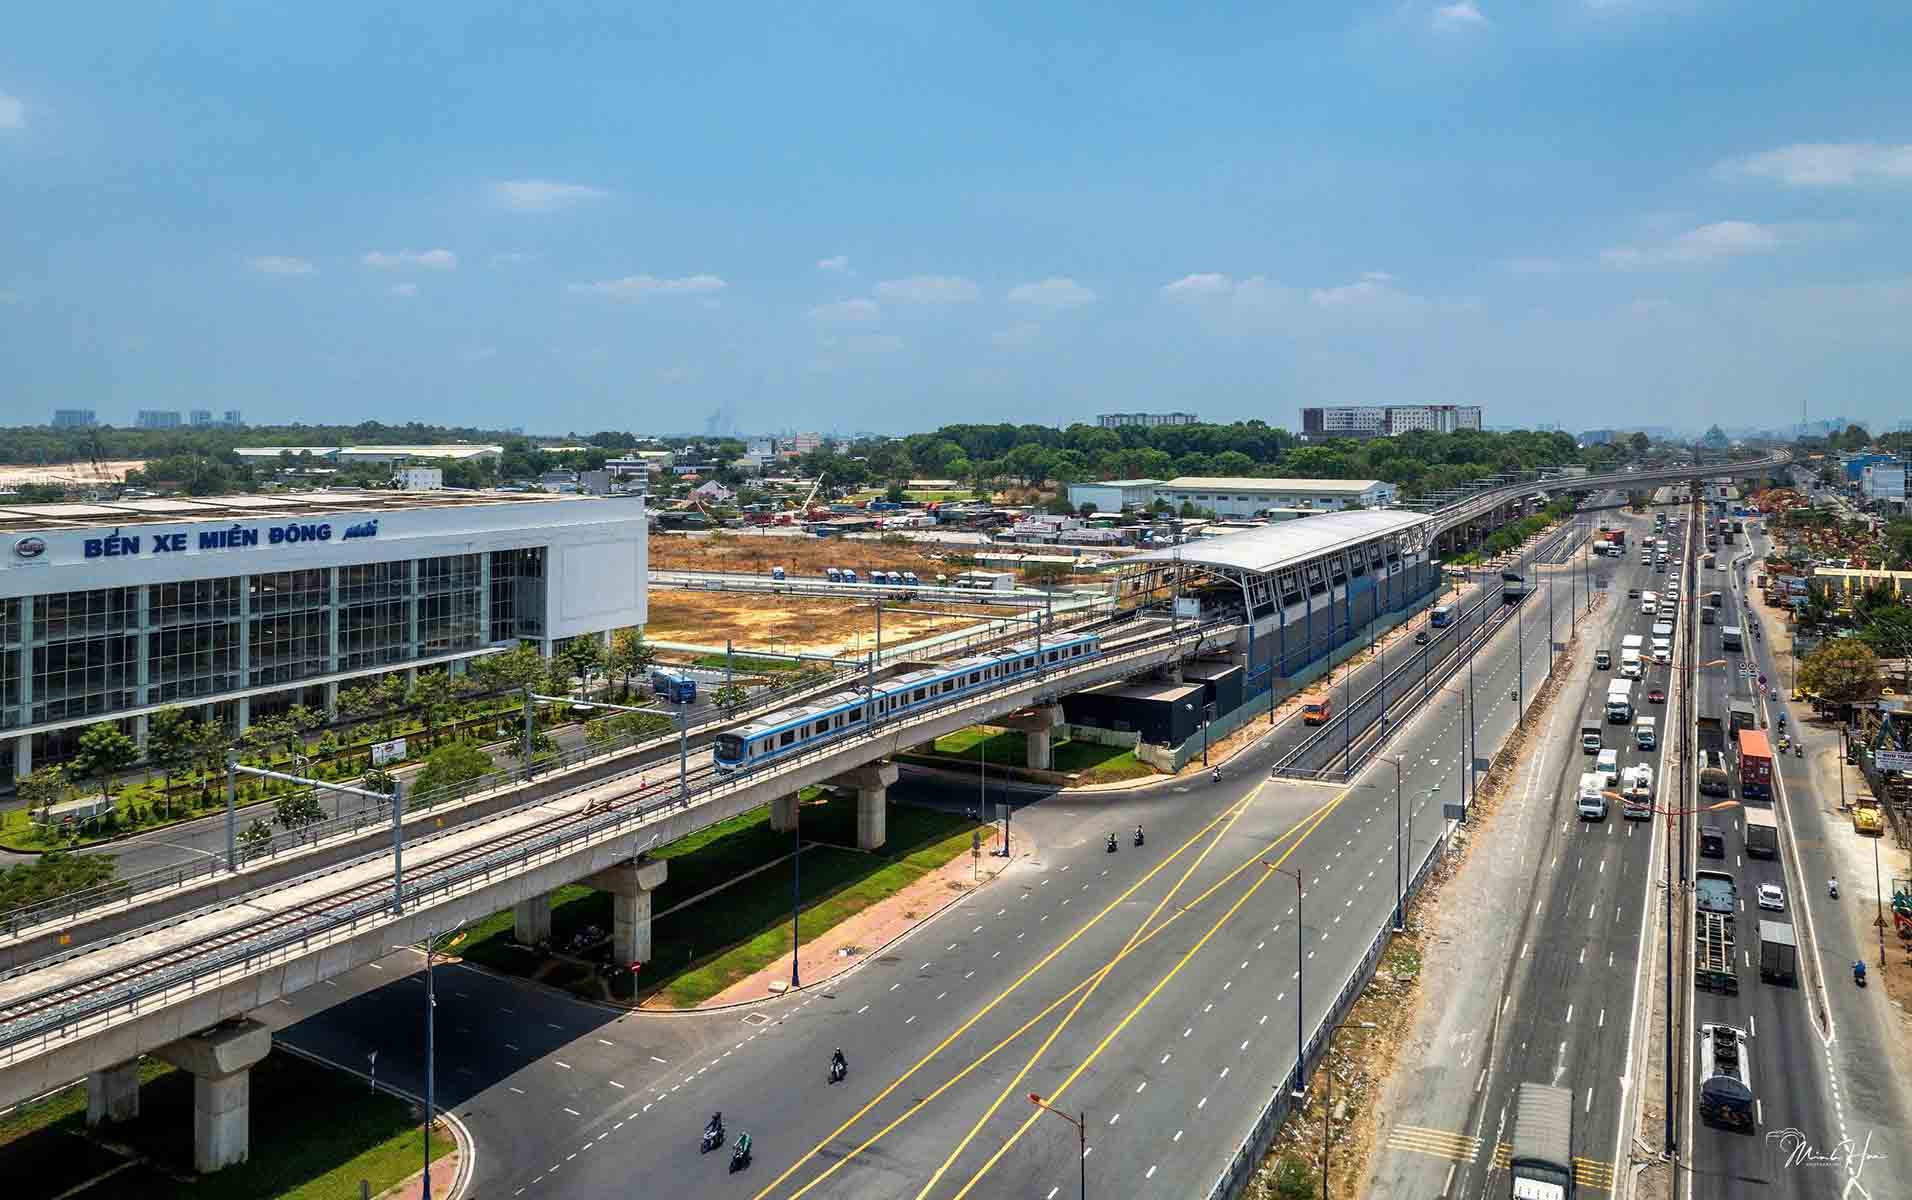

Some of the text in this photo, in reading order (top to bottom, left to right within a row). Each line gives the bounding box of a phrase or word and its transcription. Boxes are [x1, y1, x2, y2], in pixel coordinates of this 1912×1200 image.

[84, 527, 140, 558] BẾN
[152, 533, 187, 553] XE
[198, 524, 258, 549] MIỀN
[269, 523, 332, 544] ĐÔNG
